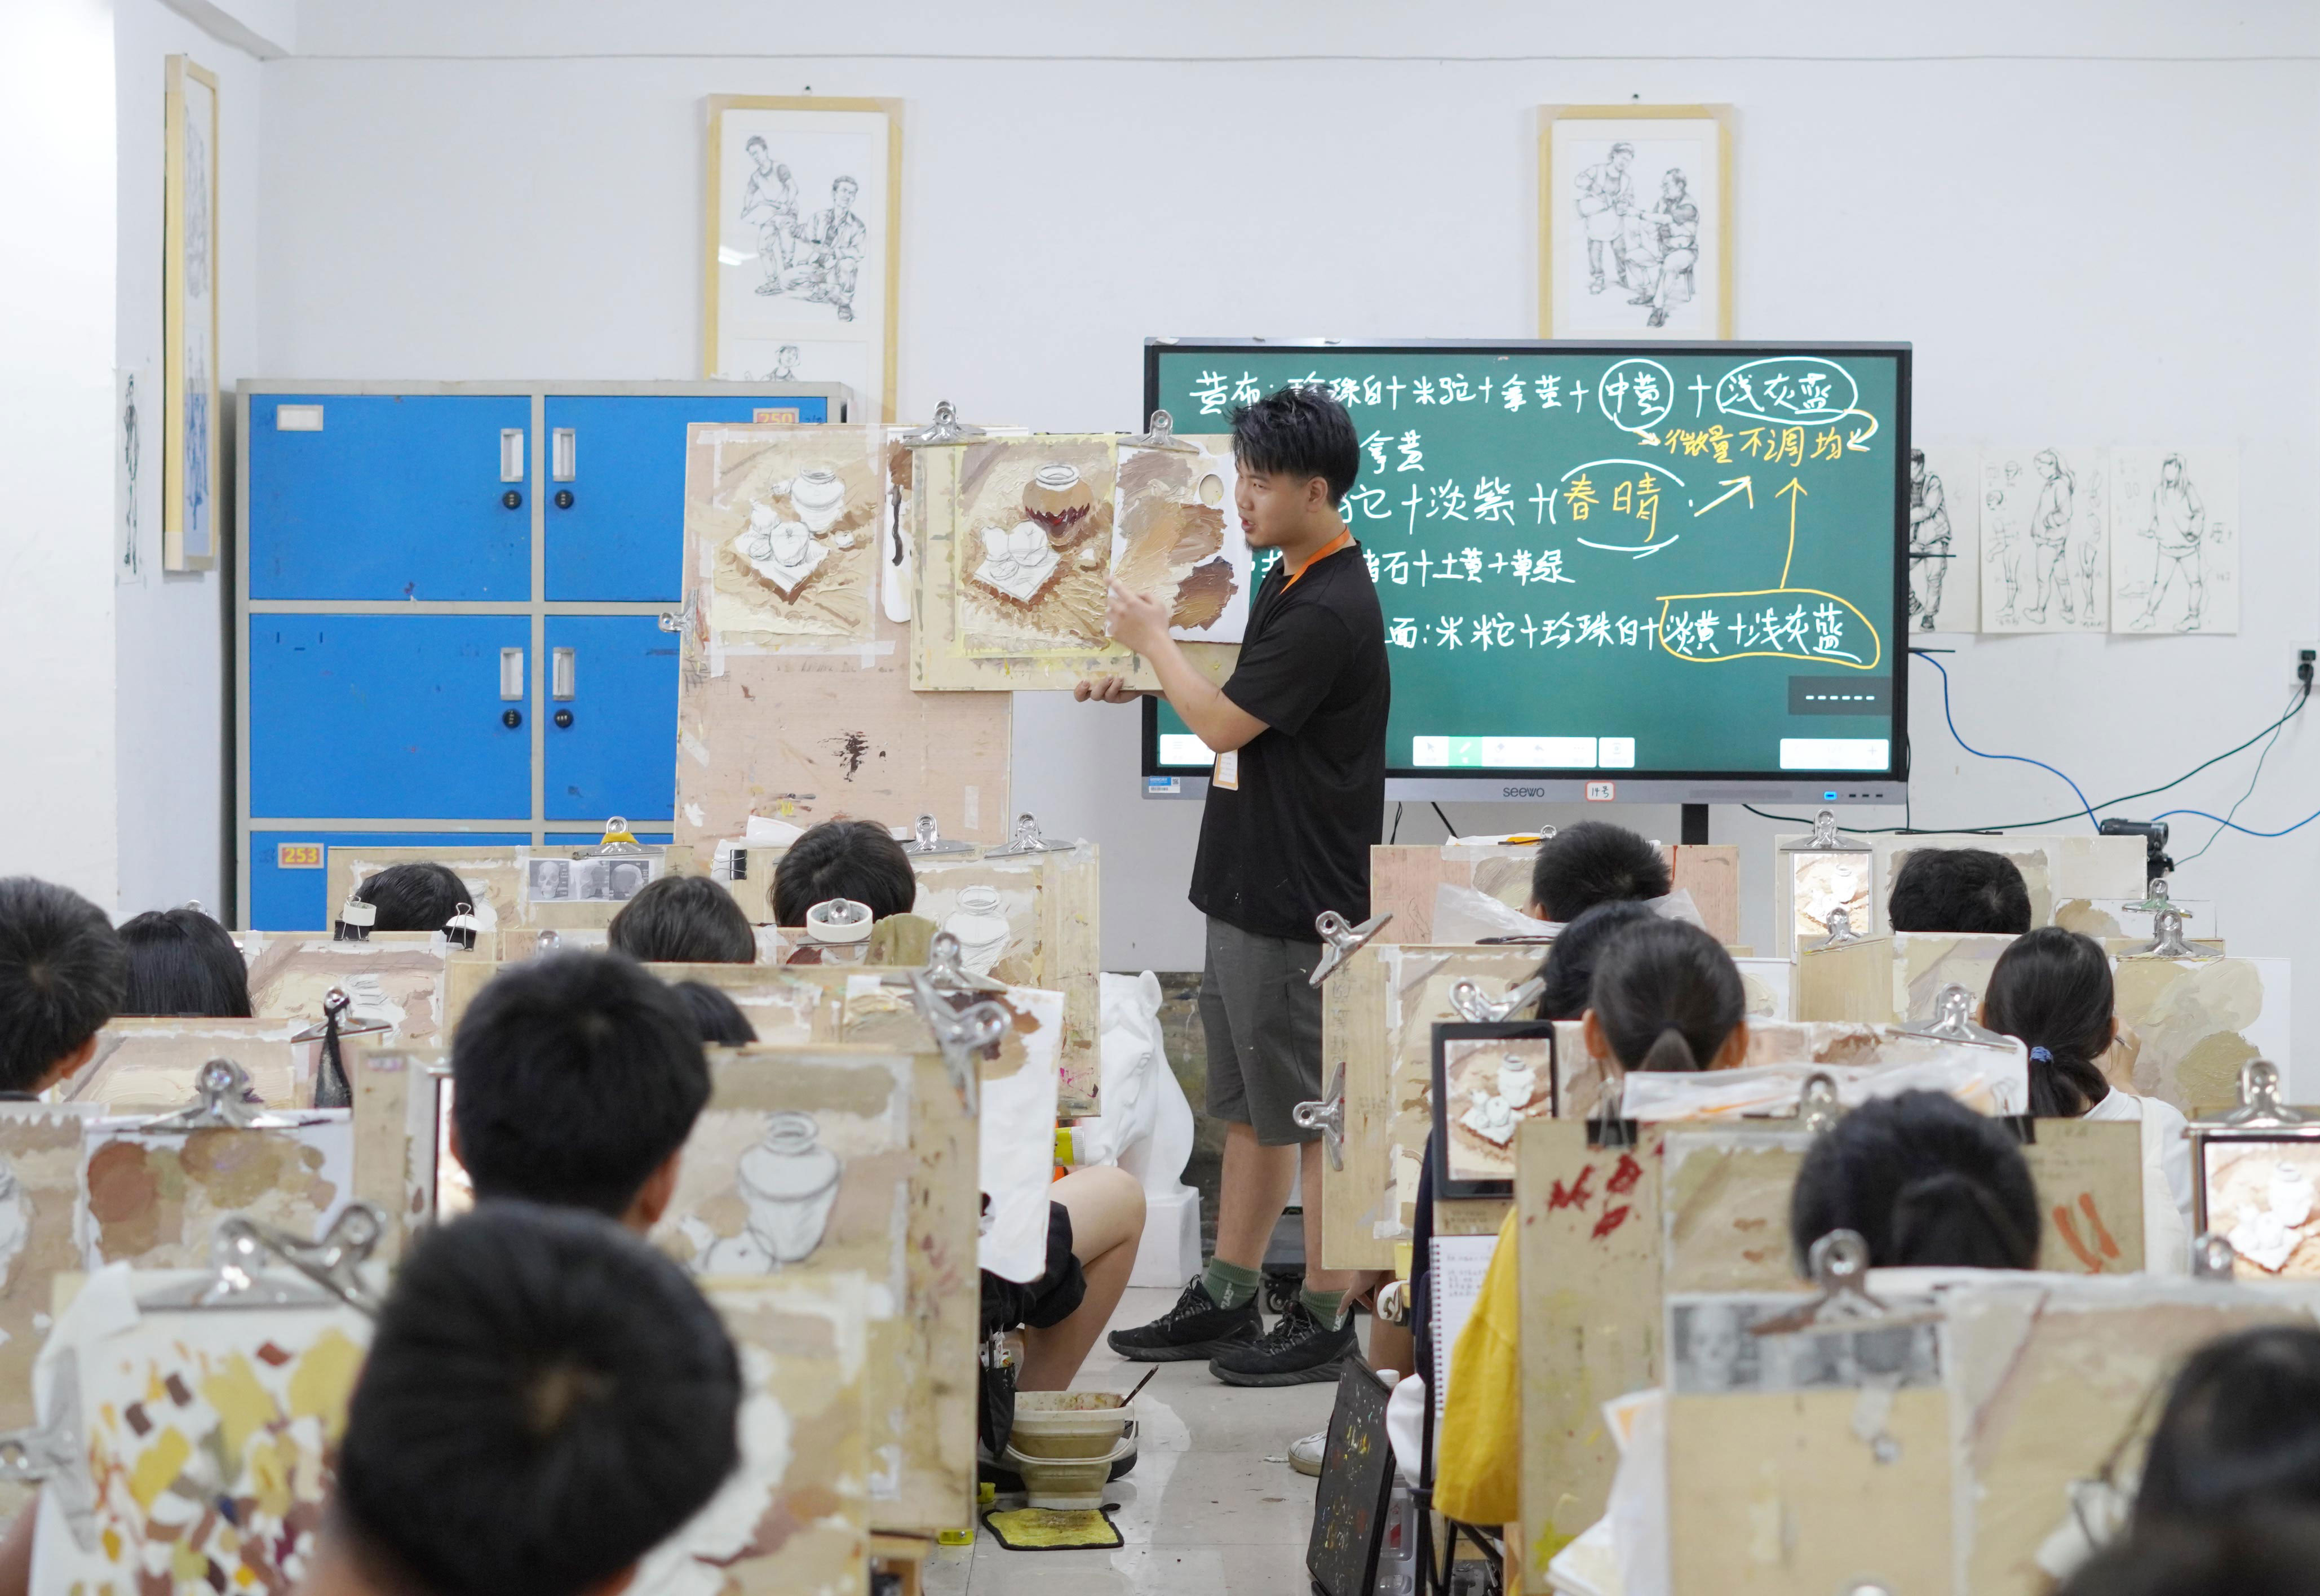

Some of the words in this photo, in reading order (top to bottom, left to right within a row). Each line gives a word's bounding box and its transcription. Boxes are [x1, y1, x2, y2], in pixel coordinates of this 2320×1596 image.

[1503, 787, 1545, 798] seewo
[1591, 786, 1609, 799] 14号
[285, 847, 318, 863] 253
